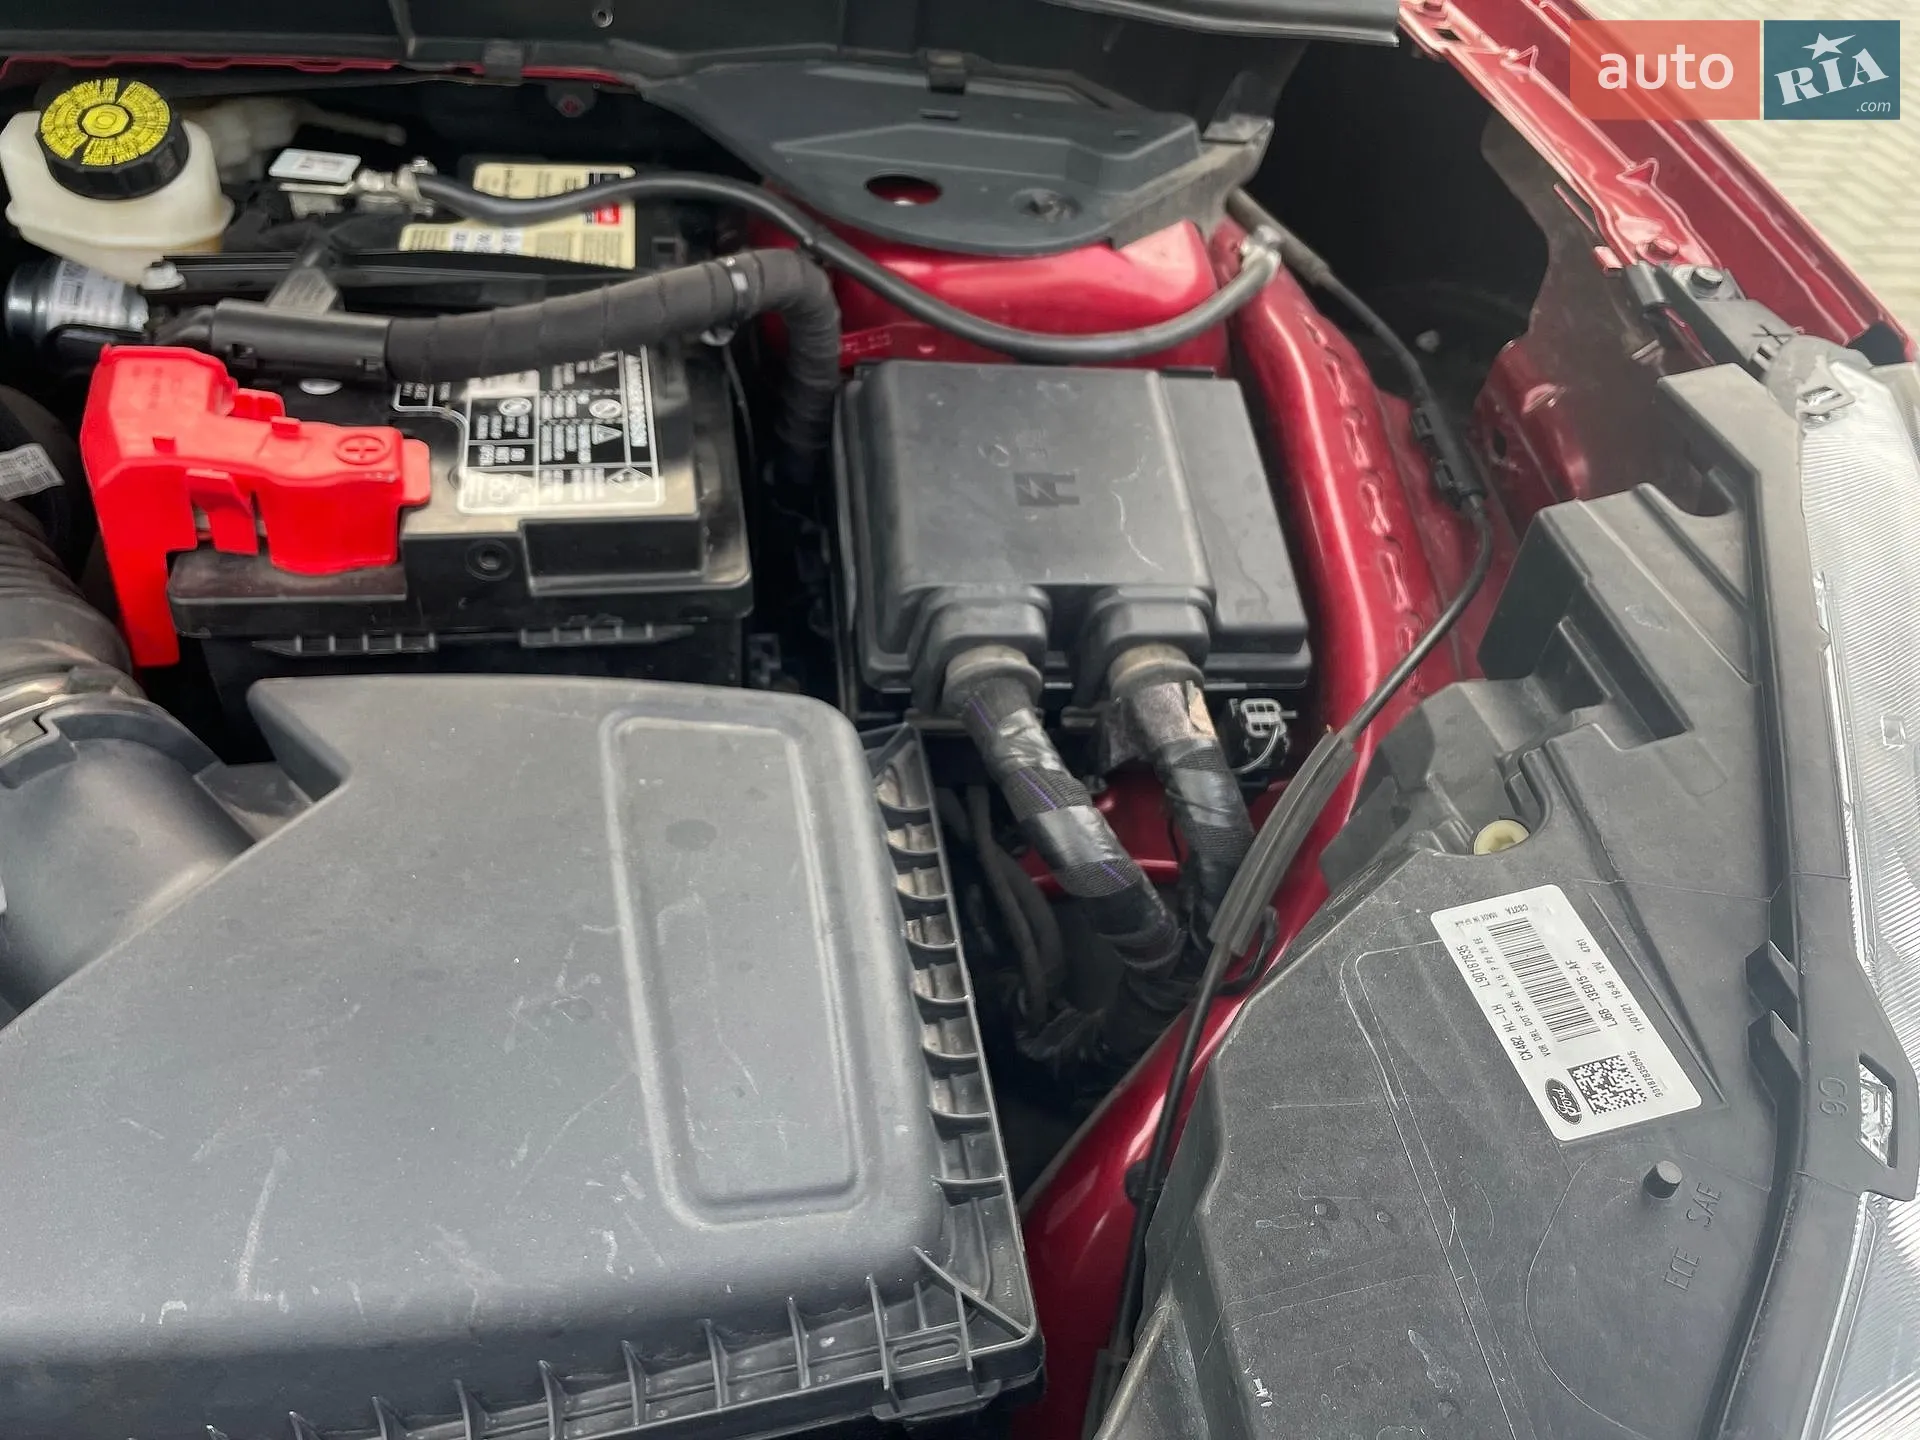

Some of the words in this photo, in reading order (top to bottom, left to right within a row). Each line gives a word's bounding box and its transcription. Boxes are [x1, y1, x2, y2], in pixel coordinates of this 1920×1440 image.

[1490, 1003, 1516, 1032] HL-LH
[1510, 1000, 1524, 1012] SAE
[1518, 1014, 1533, 1026] DOT
[1509, 1035, 1533, 1060] CX482
[1527, 1028, 1542, 1041] DRL
[1551, 1087, 1582, 1117] Ford
[1686, 1182, 1722, 1228] SAE
[1663, 1247, 1701, 1291] ECE
